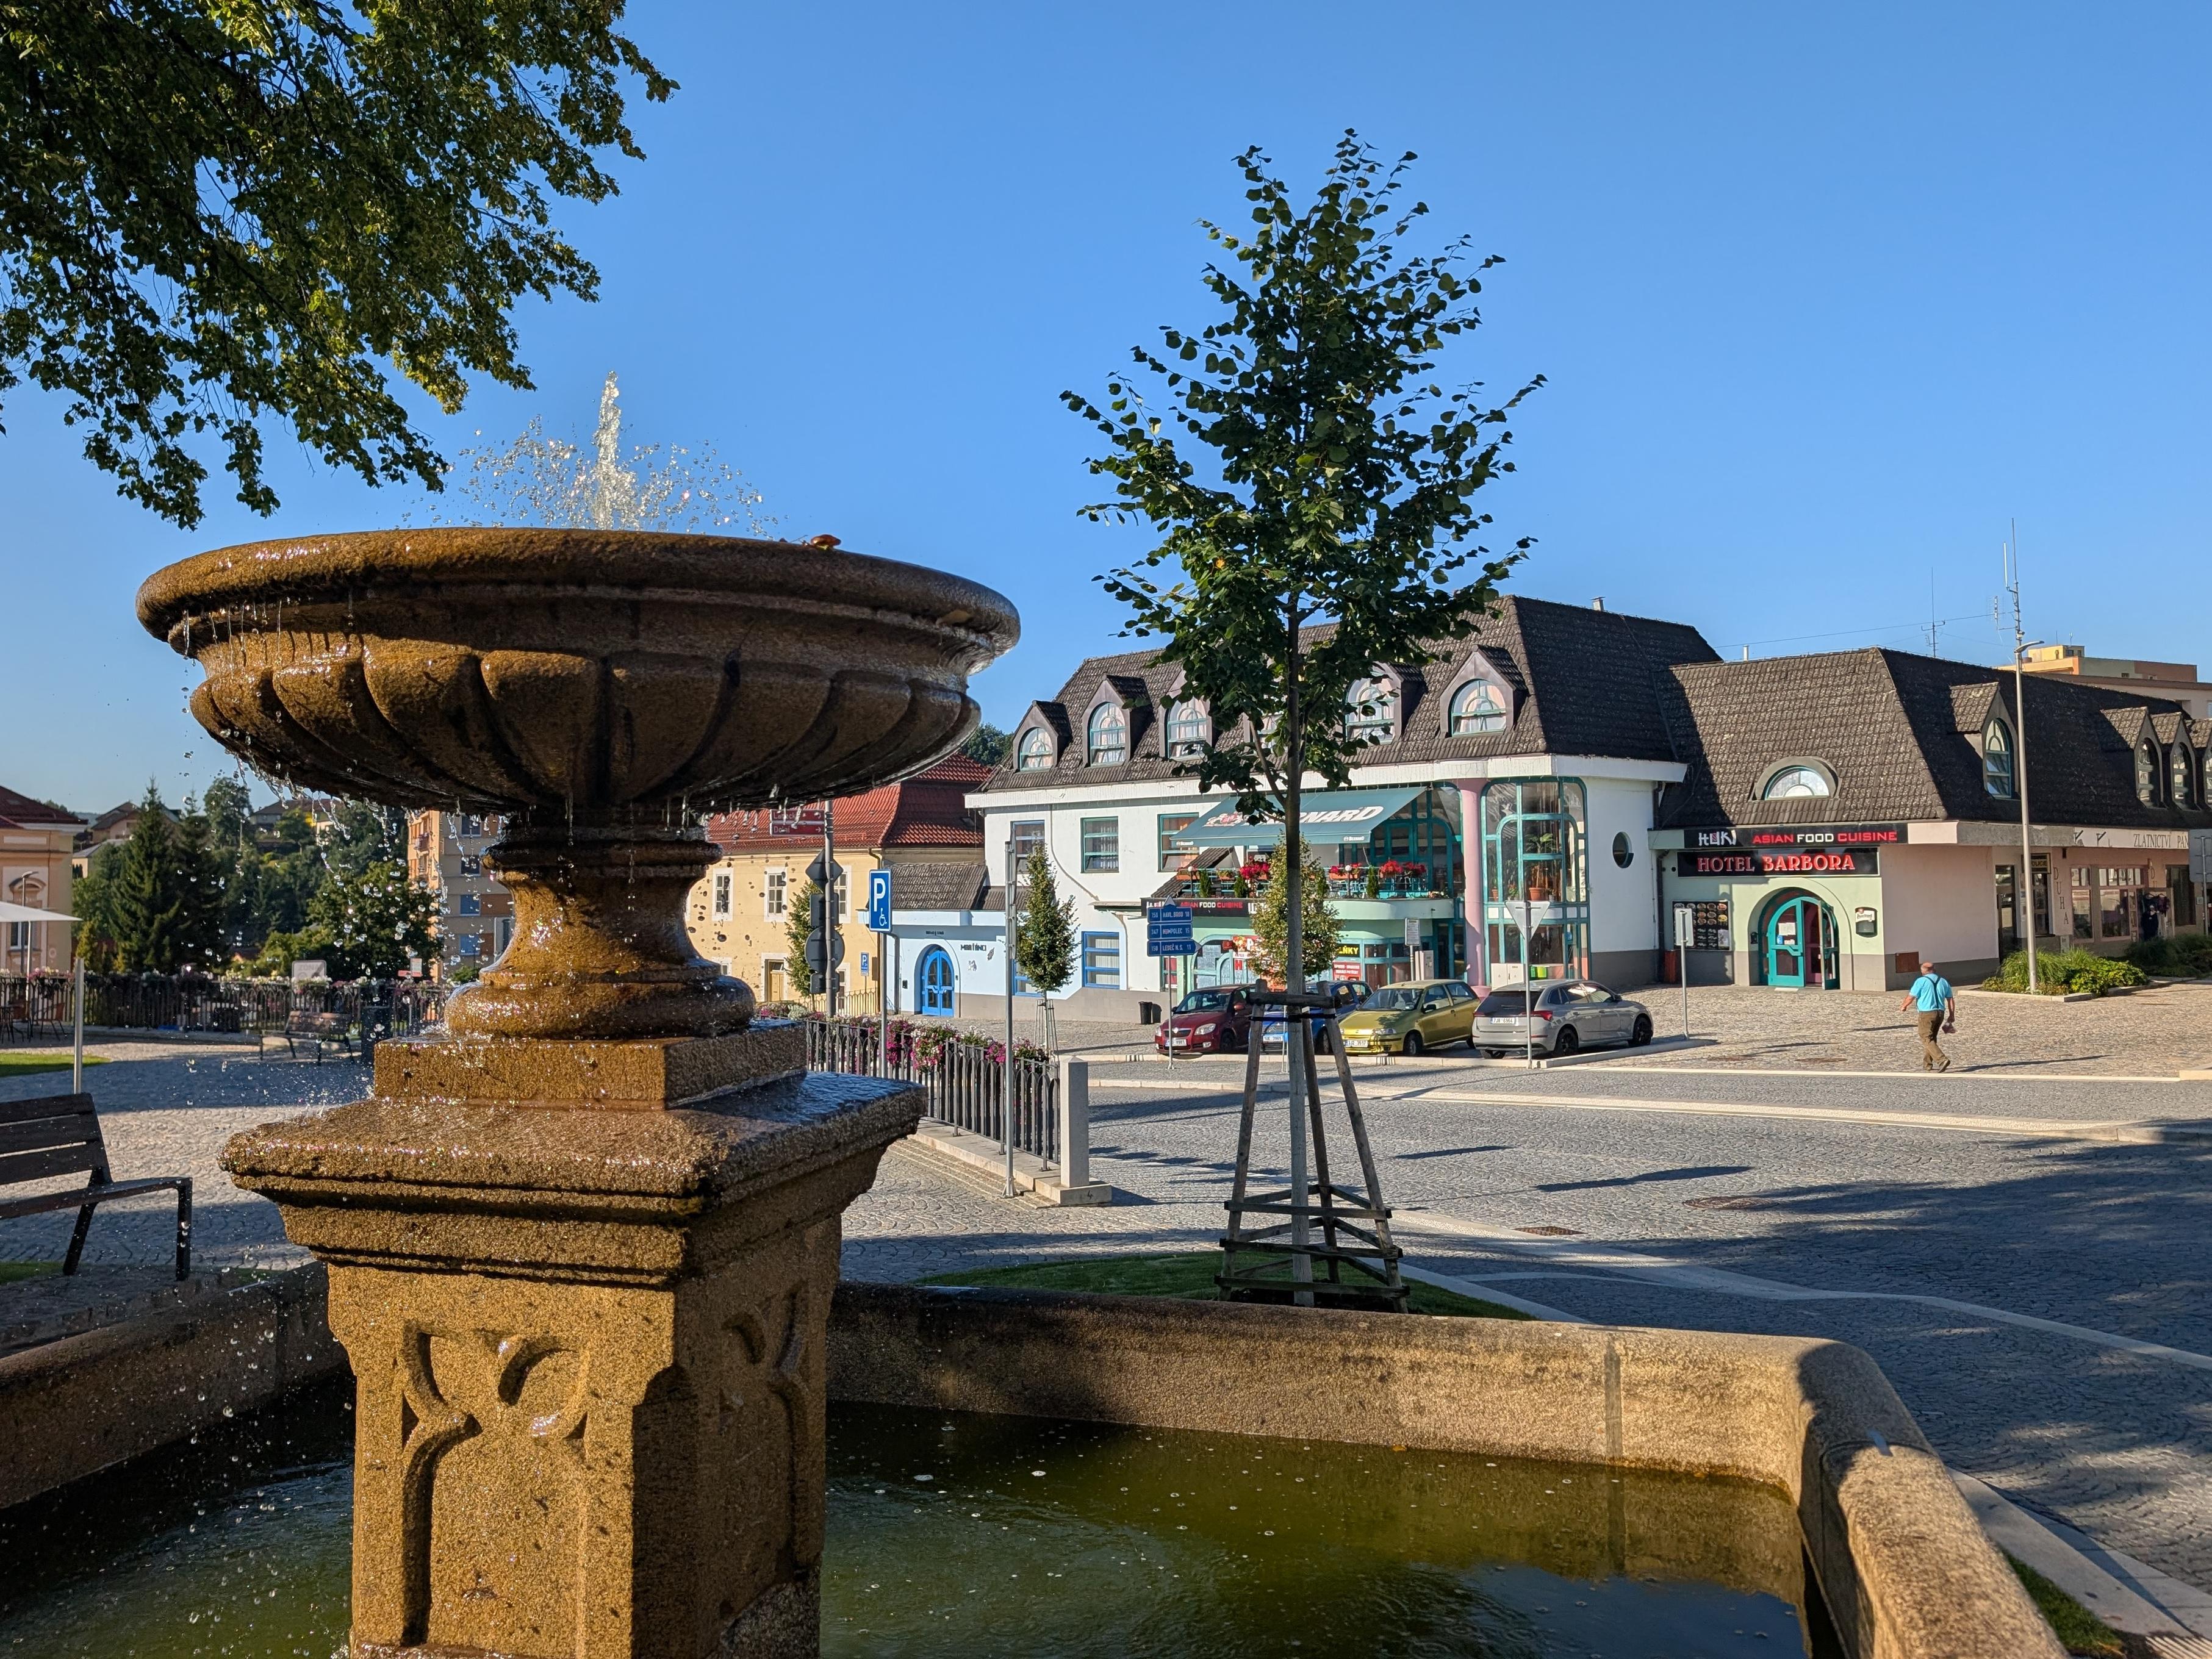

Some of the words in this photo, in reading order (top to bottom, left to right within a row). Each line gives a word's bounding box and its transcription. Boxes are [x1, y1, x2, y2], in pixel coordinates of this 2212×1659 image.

[1752, 834, 1794, 844] ASIAN
[1797, 833, 1834, 843] FOOD
[1837, 831, 1898, 842] CUISINE
[2133, 832, 2172, 848] ZLATNICTVÍ
[1697, 856, 1756, 872] HOTEL
[1762, 855, 1856, 872] BARBORA
[874, 878, 886, 912] P
[2053, 867, 2069, 925] DUHA
